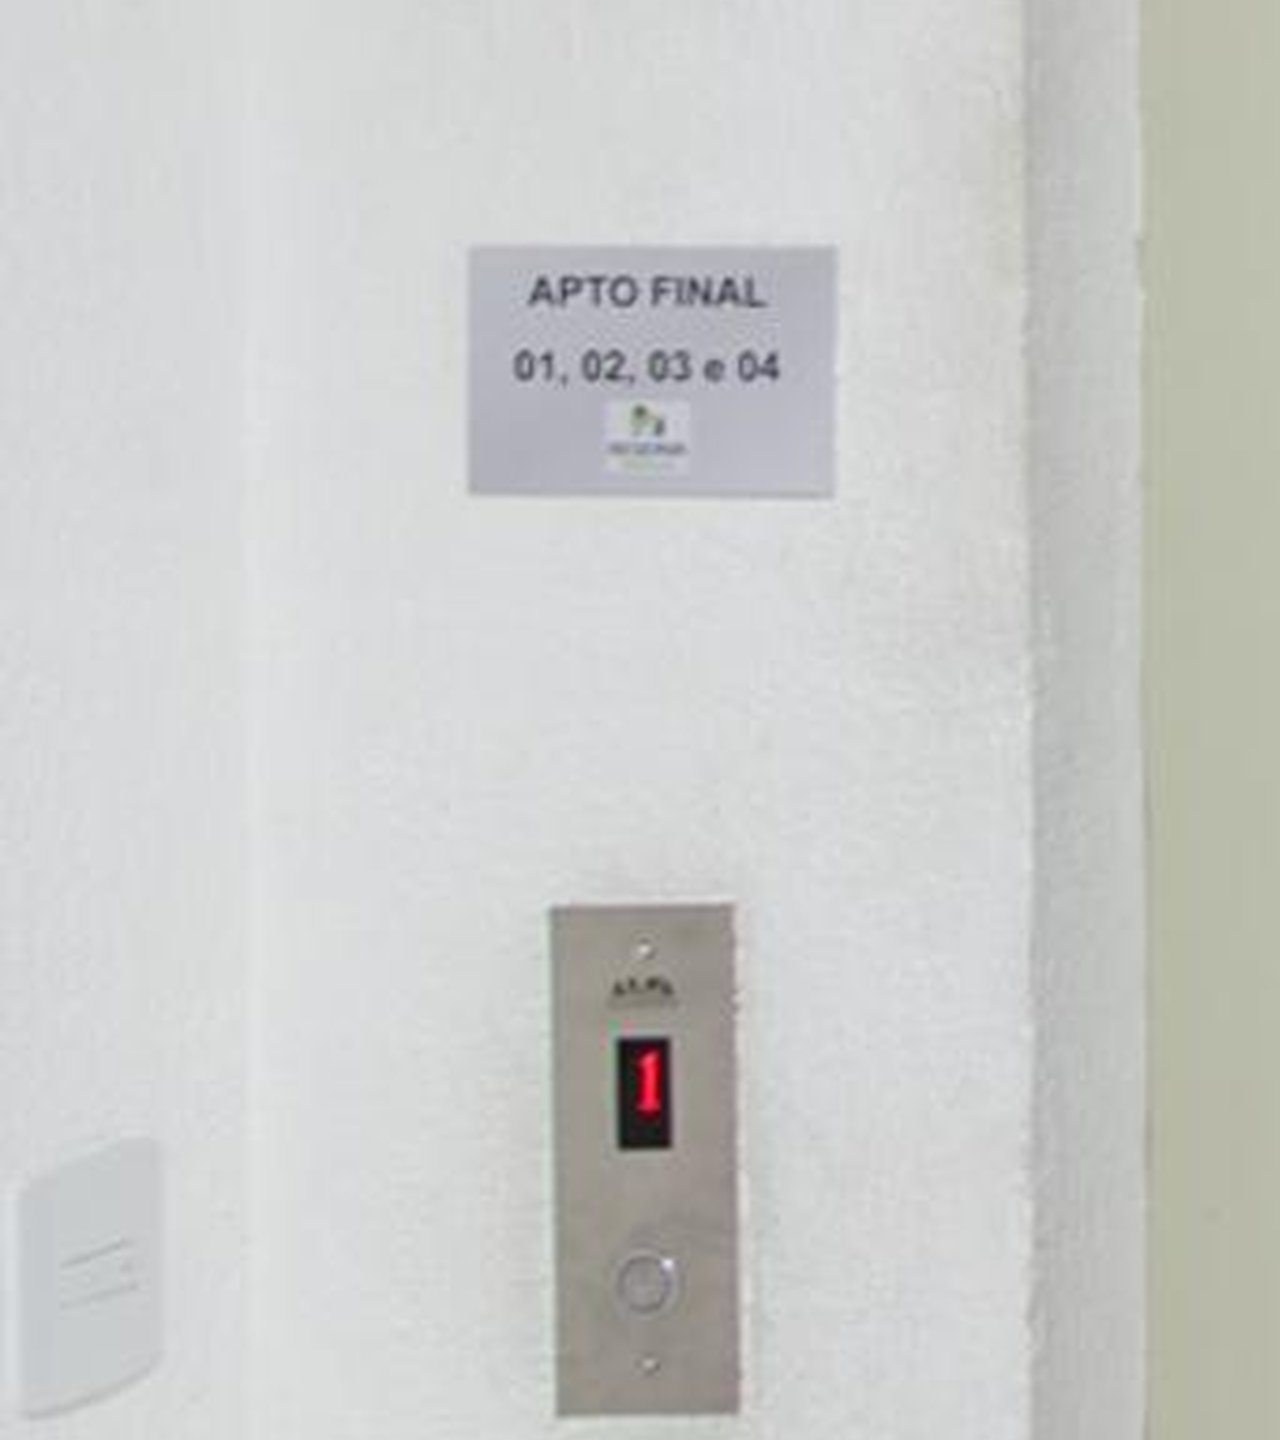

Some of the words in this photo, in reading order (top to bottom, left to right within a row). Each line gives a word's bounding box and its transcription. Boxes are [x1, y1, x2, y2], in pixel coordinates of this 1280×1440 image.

[527, 274, 639, 309] APTO
[650, 274, 769, 309] FINAL
[512, 349, 569, 386] 01,
[580, 349, 635, 386] 02,
[647, 349, 693, 383] 03
[703, 357, 726, 383] e
[736, 349, 782, 383] 04
[634, 1049, 661, 1114] 1
